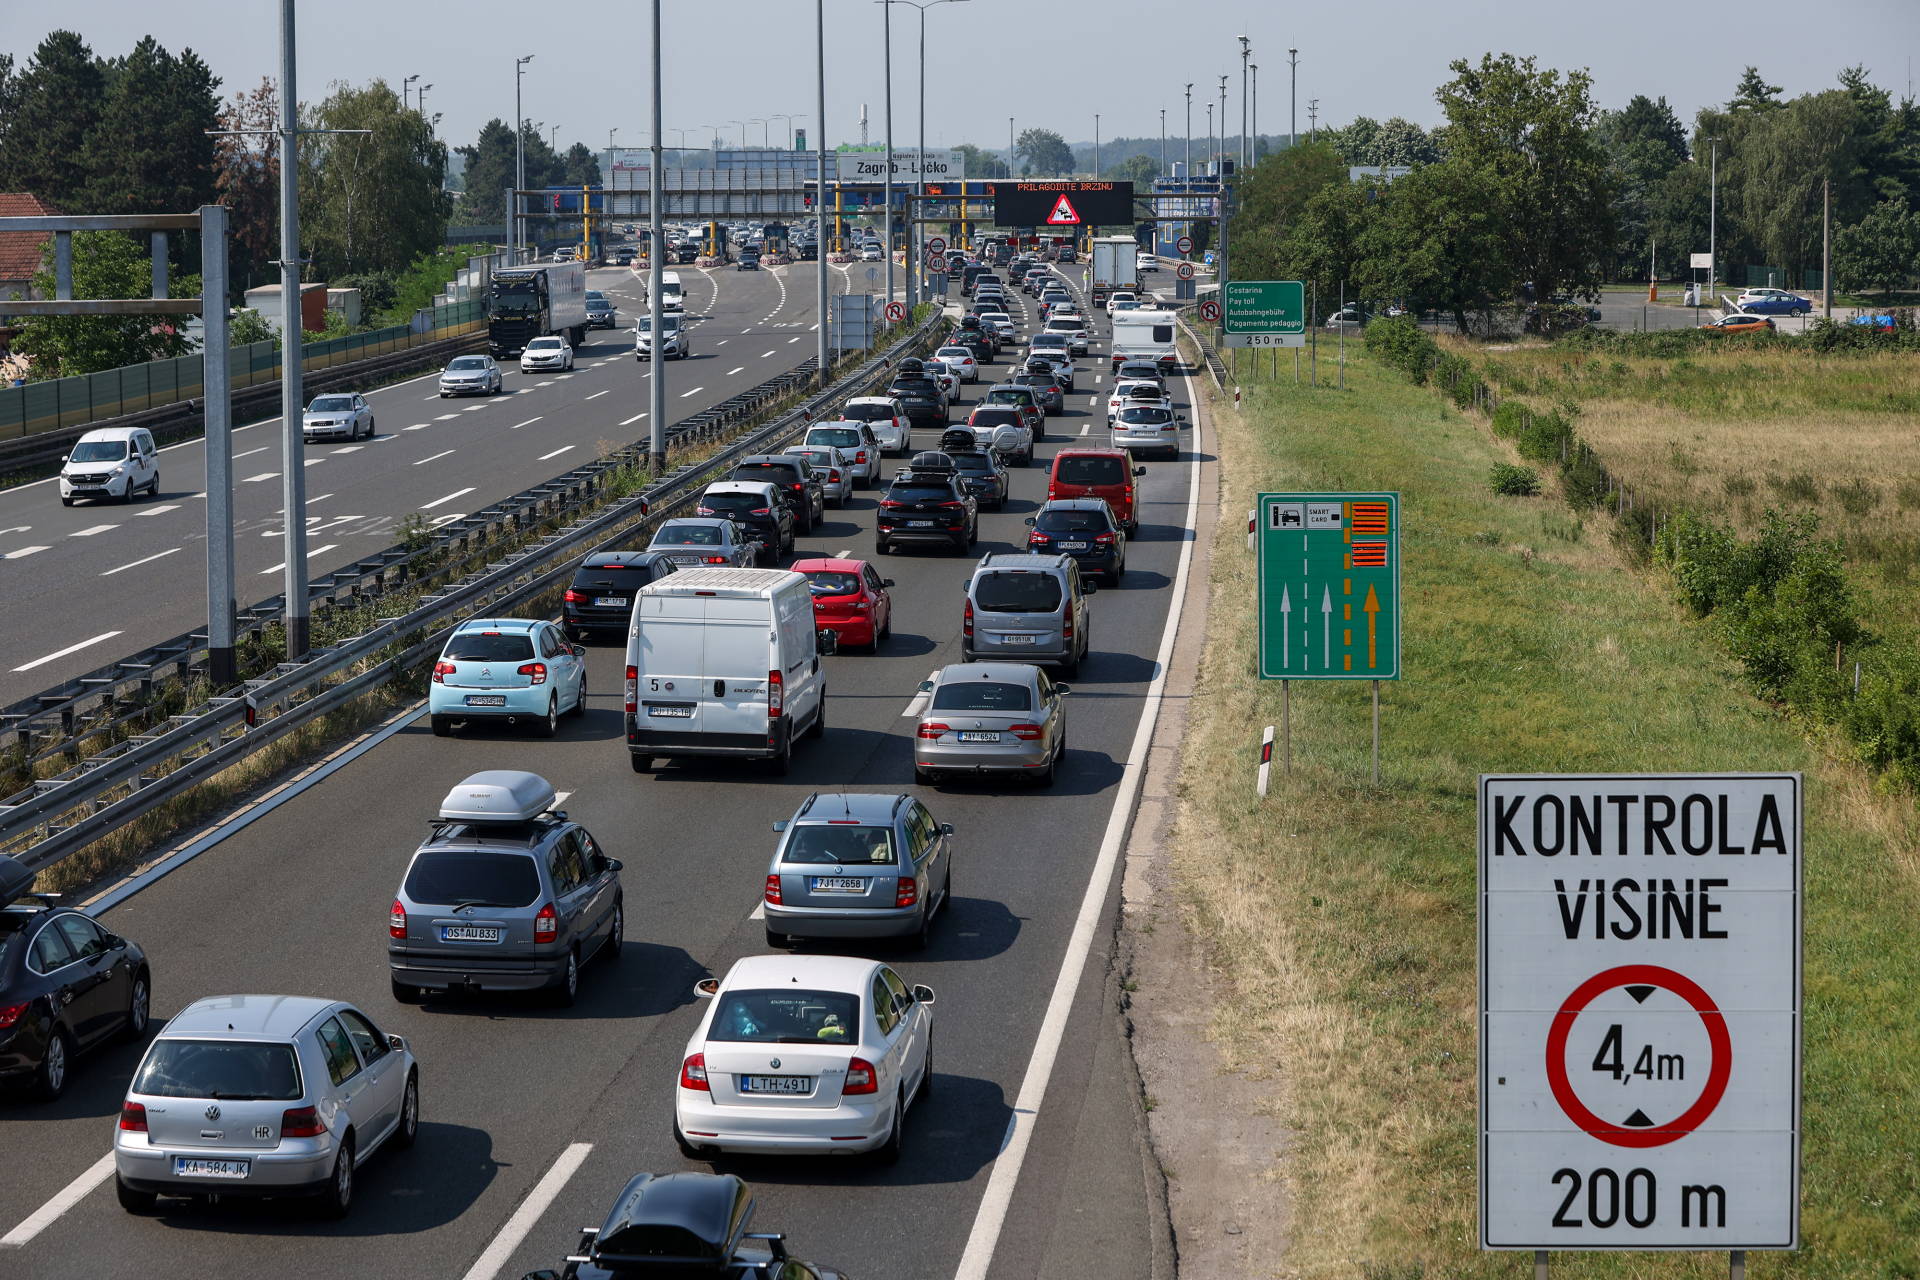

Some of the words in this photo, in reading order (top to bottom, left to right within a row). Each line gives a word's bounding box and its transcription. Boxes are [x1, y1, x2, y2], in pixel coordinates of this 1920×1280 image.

[1017, 183, 1076, 191] PRILAGODITE
[1080, 183, 1113, 191] BRZINU
[932, 259, 942, 267] 40
[1180, 266, 1191, 276] 40
[1229, 298, 1242, 306] Pay
[1229, 309, 1285, 317] Autobahngebühr
[1229, 320, 1269, 328] Pagamento
[1270, 320, 1302, 328] pedaggio
[651, 679, 658, 691] 5
[1494, 793, 1788, 857] KONTROLA
[819, 879, 834, 888] 7J1
[840, 879, 861, 888] 2658
[1553, 877, 1729, 941] VISINE
[447, 928, 460, 938] OS
[465, 929, 478, 938] AU
[479, 929, 497, 939] 833
[1591, 1023, 1686, 1086] 4,4m
[751, 1077, 805, 1090] LTH-491
[254, 1126, 270, 1138] HR
[185, 1161, 199, 1173] KA
[1551, 1167, 1657, 1229] 200
[1681, 1182, 1727, 1229] m
